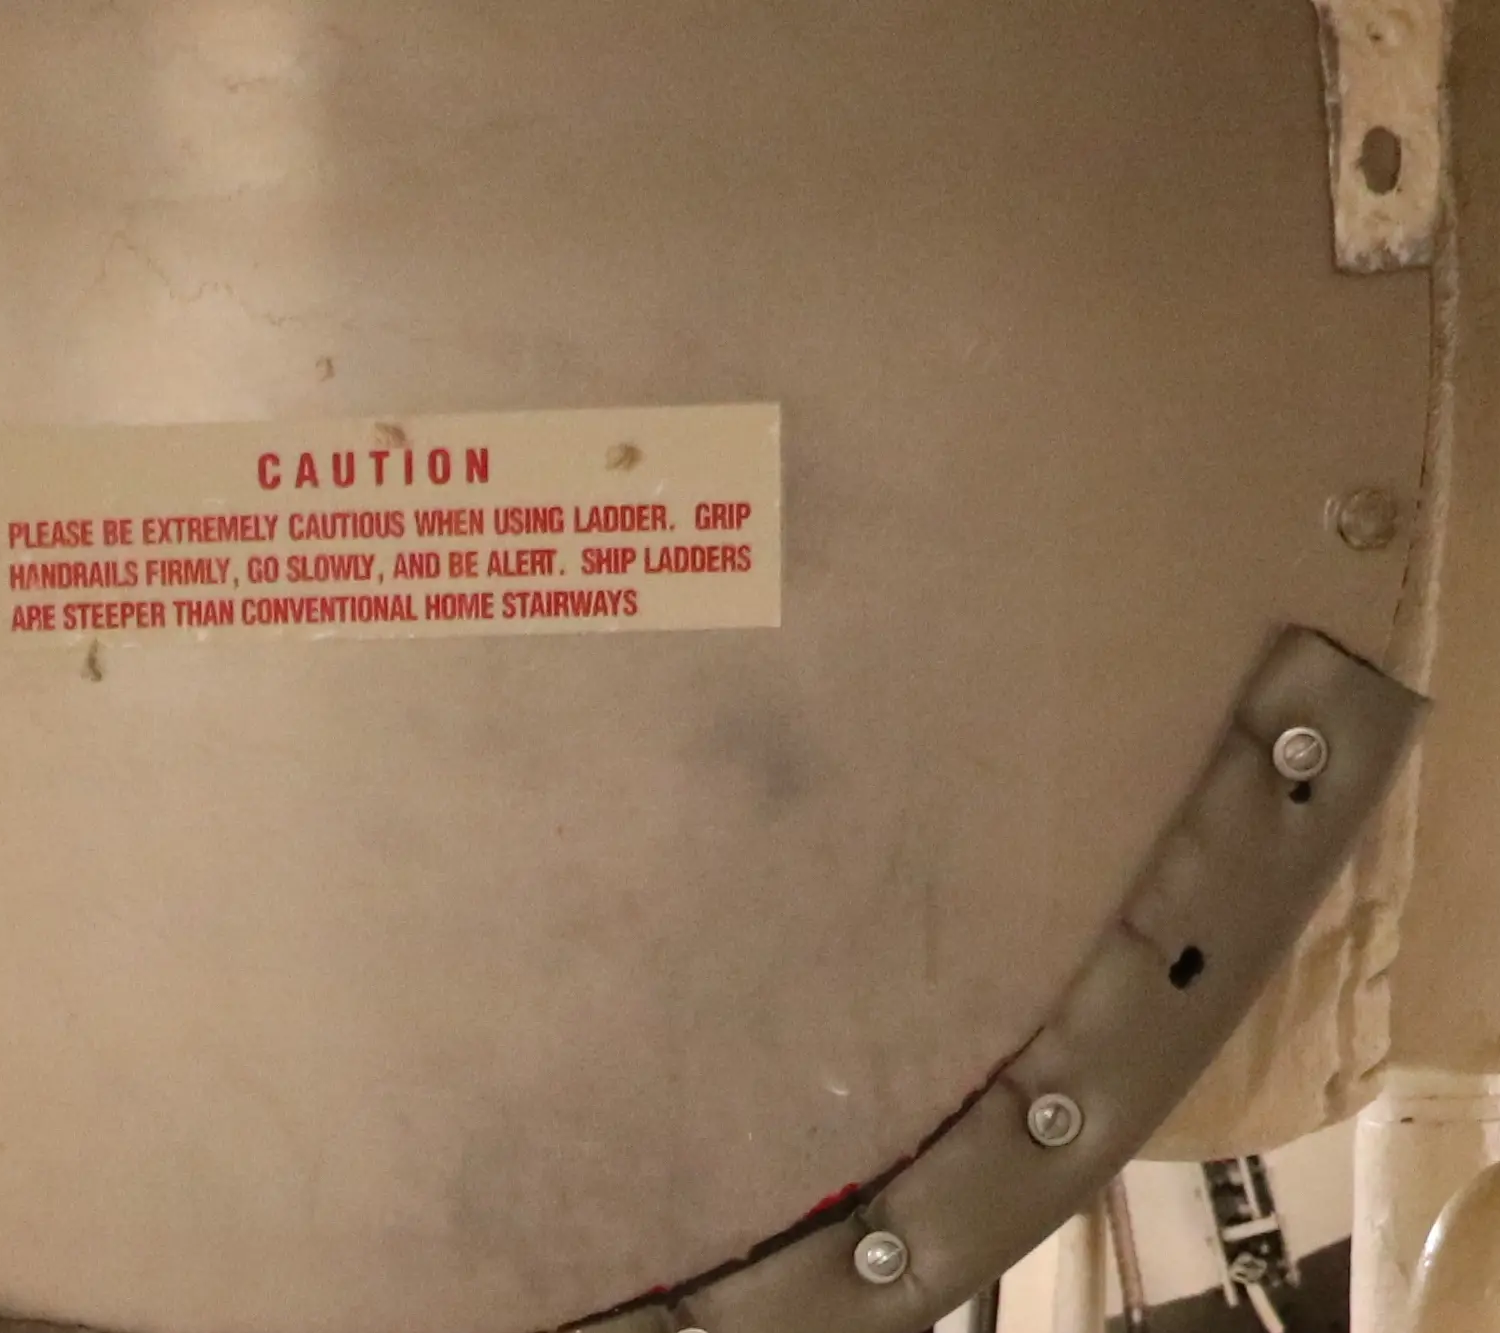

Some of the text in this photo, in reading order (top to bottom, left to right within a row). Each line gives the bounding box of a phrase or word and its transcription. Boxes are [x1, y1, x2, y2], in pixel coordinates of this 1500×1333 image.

[257, 447, 490, 490] CAUTION
[8, 502, 752, 550] PLEASE BE EXTREMELY CAUTIOUS WHEN USING LADDER. GRIP
[9, 544, 752, 591] HANDRAILS FIRMLY, GO SLOWLY, AND BE ALERT. SHIP LADDERS
[11, 588, 637, 632] ARE STEEPER THAN CONVENTIONAL HOME STAIRWAYS
